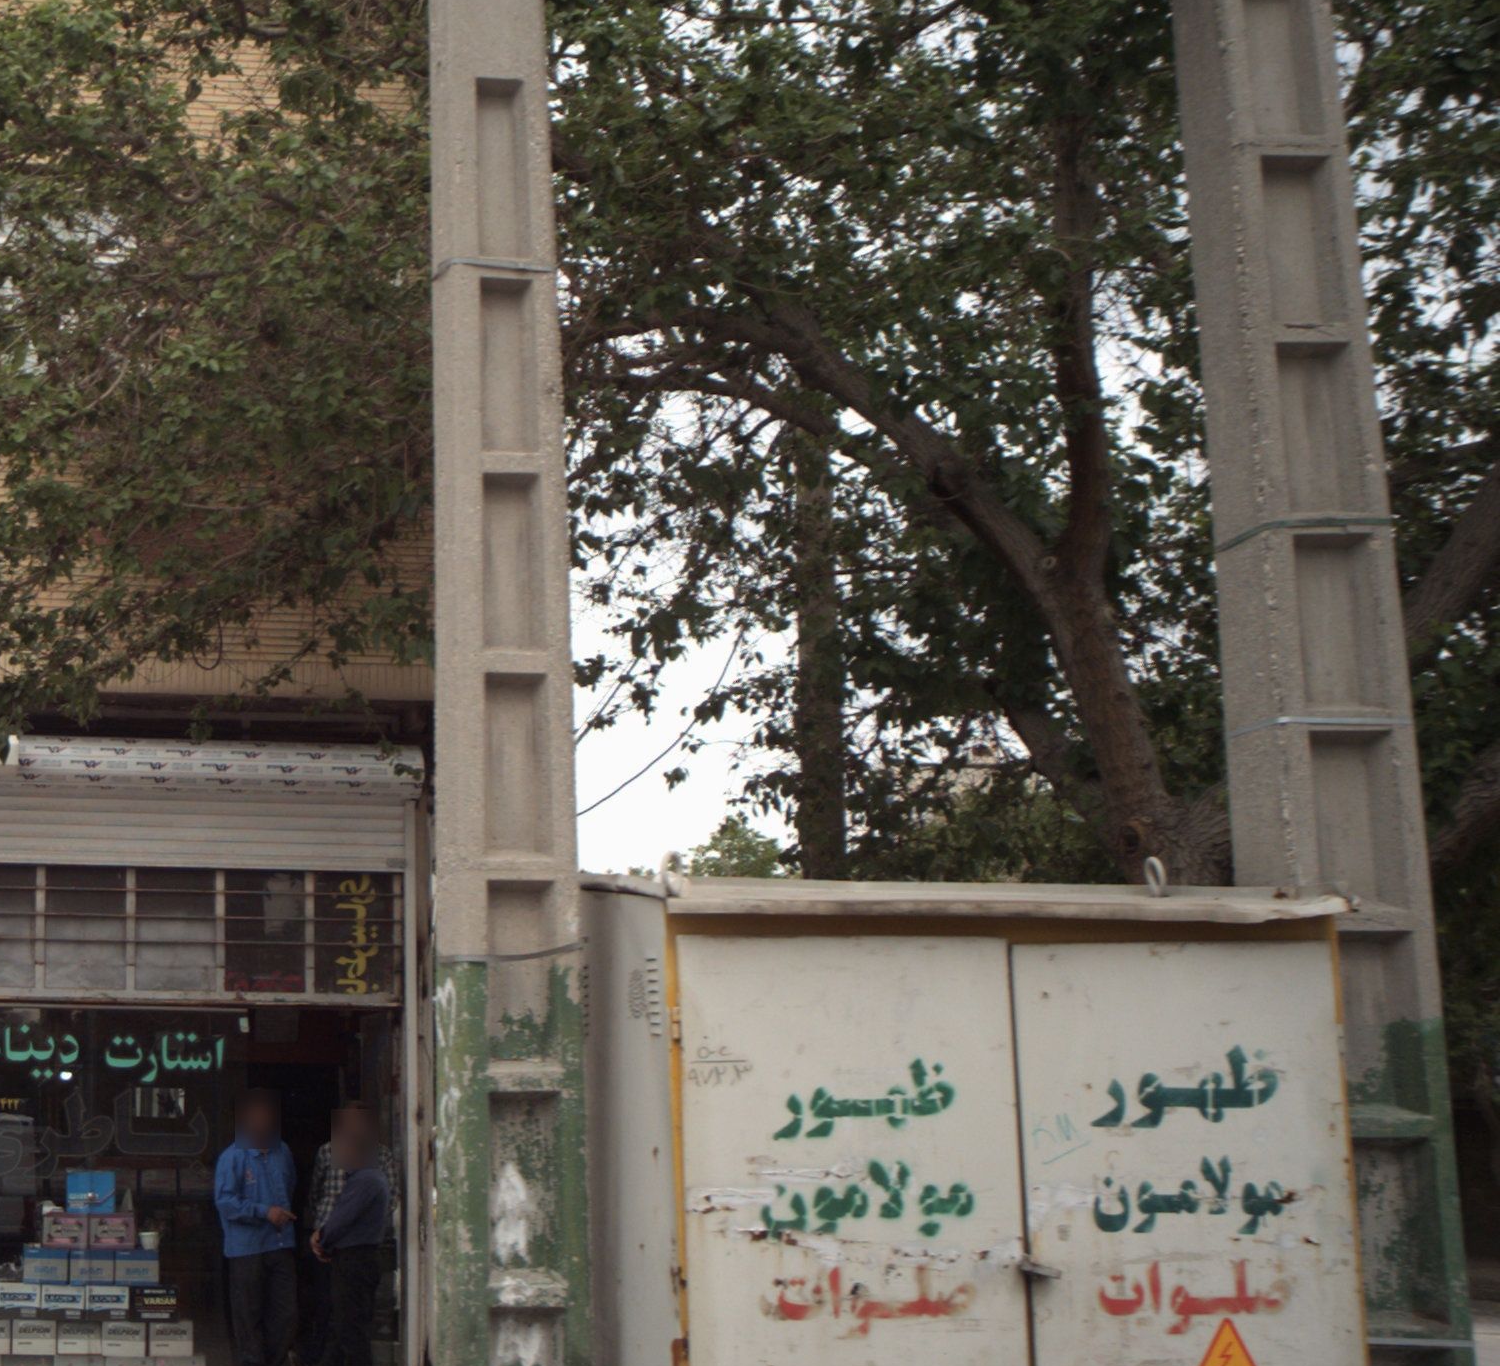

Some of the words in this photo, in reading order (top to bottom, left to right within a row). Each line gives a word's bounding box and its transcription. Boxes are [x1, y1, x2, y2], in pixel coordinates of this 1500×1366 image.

[104, 1031, 225, 1084] استارت
[771, 1057, 956, 1142] ظهور
[1089, 1044, 1280, 1129] ظهور
